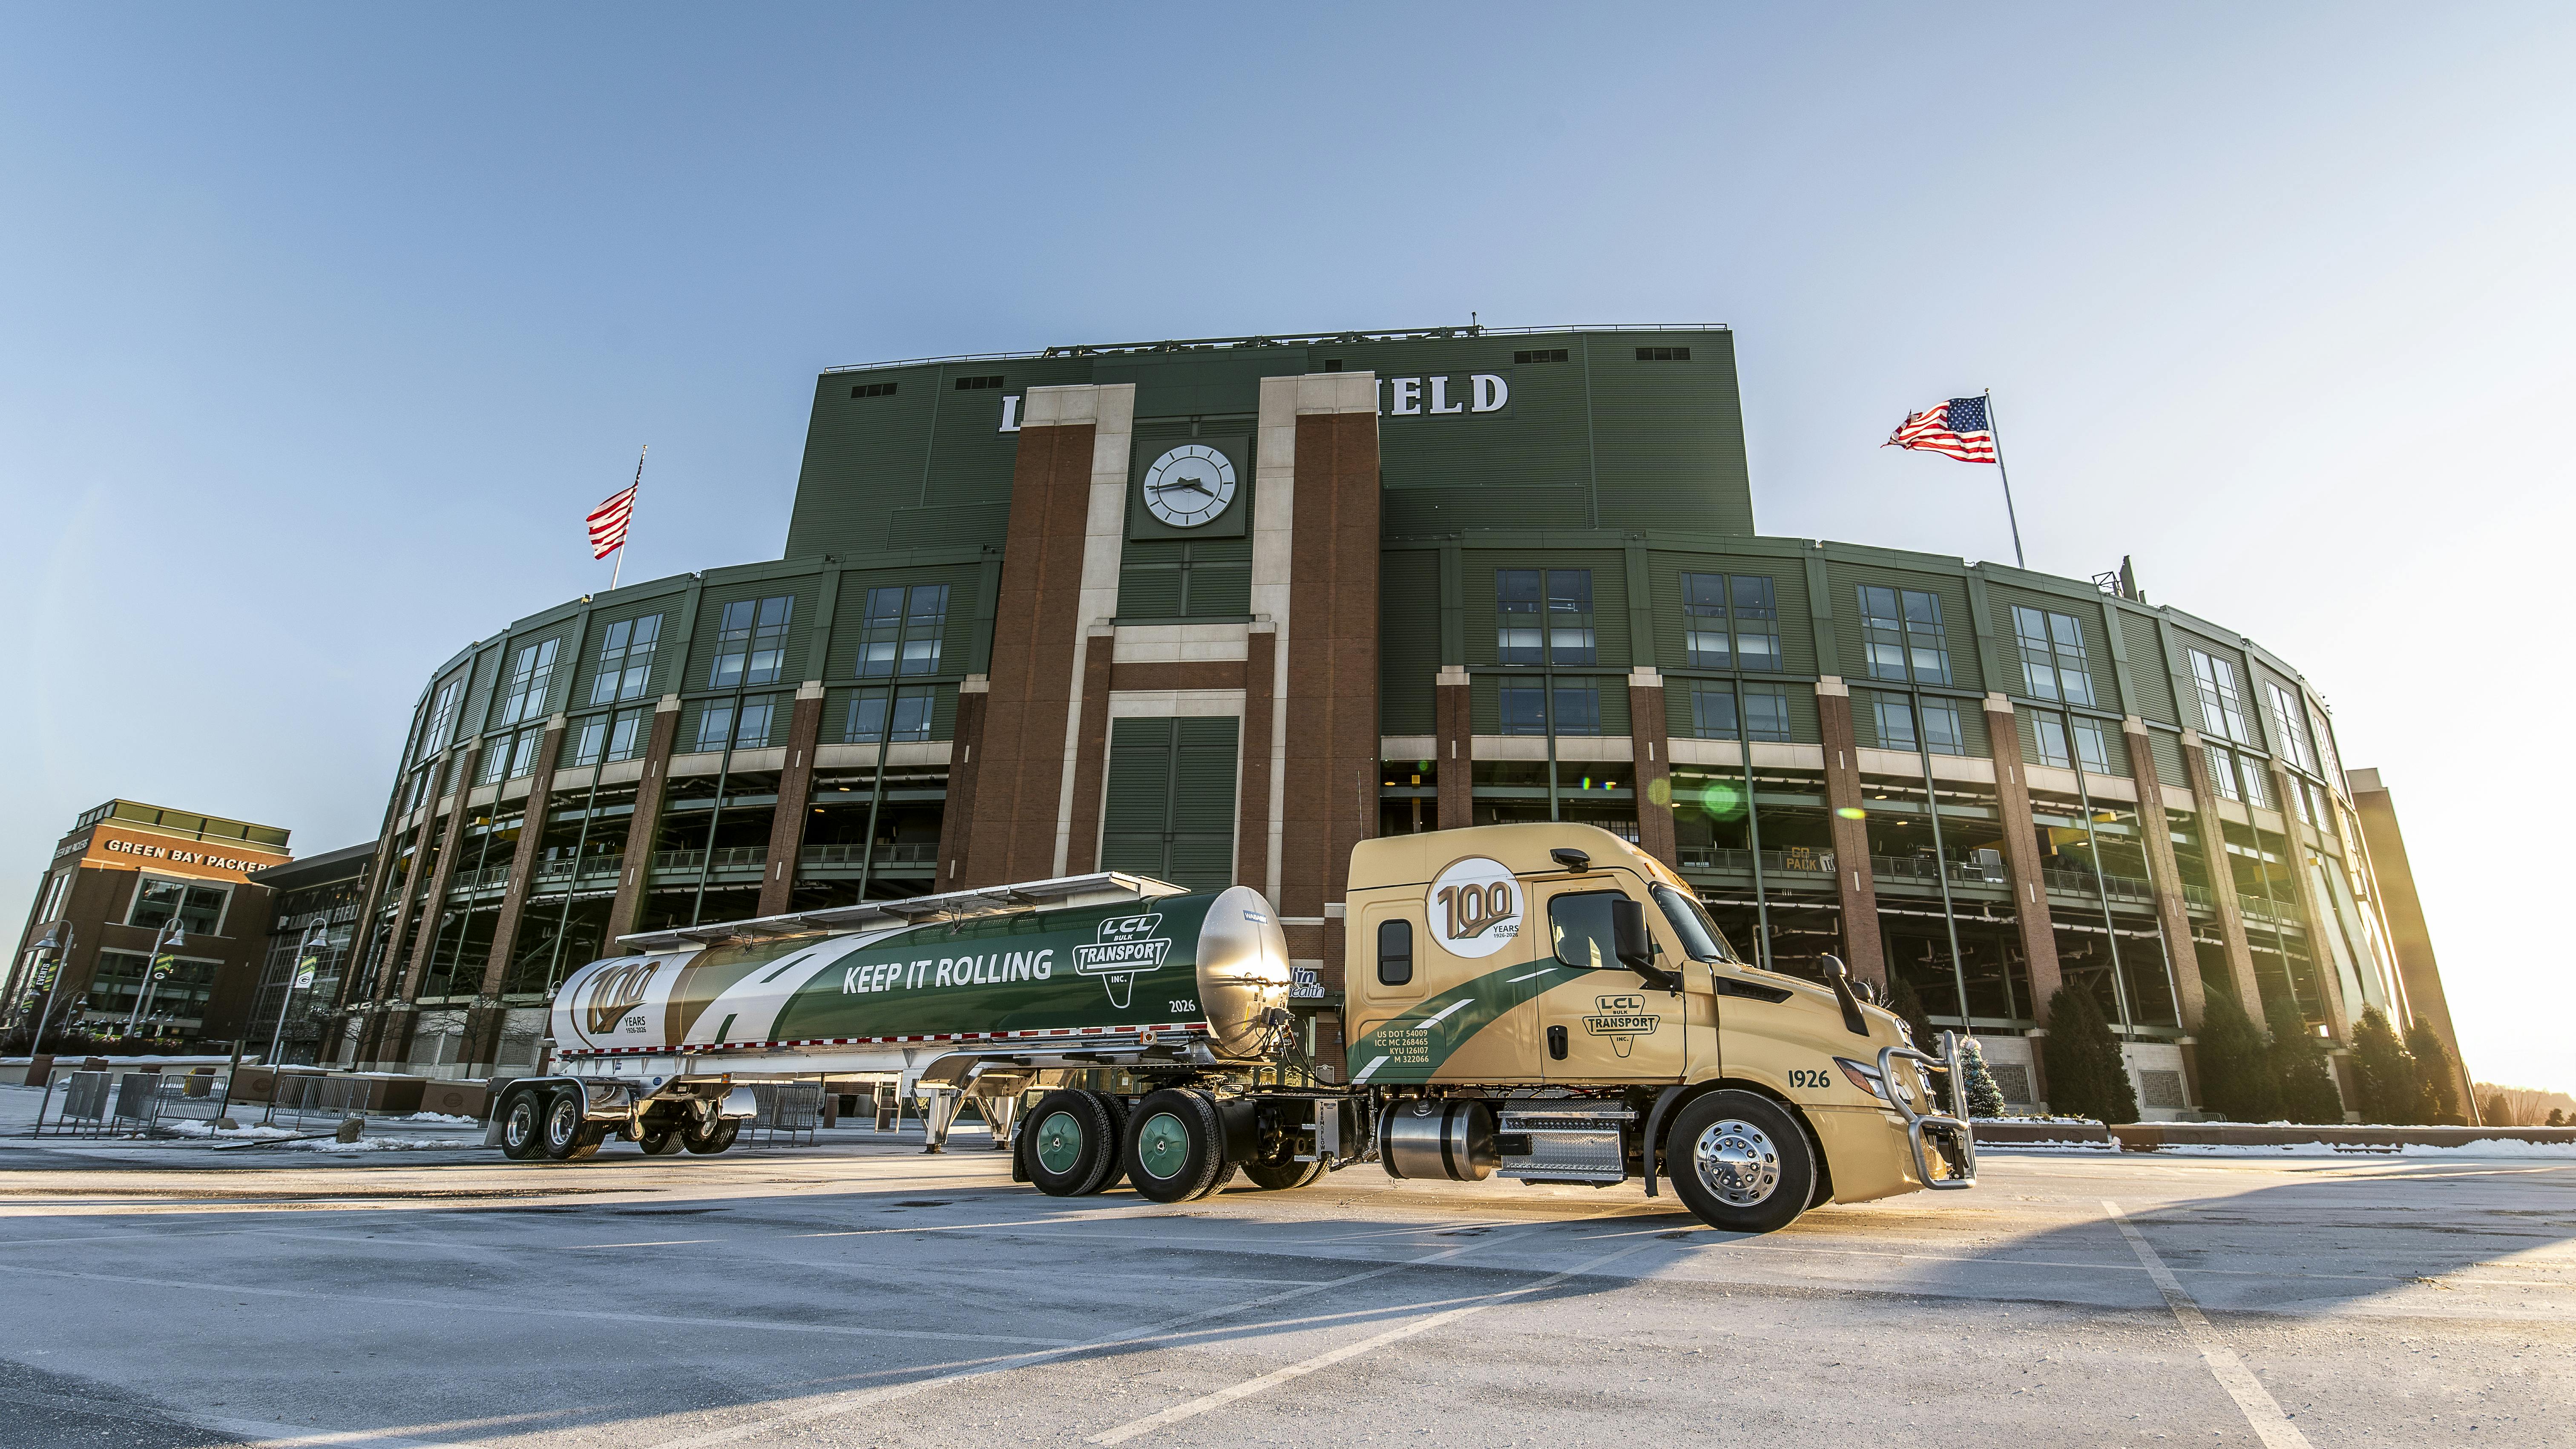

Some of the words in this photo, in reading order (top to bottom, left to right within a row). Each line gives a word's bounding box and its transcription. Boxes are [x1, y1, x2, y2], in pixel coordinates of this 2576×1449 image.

[108, 840, 166, 858] GREEN
[171, 850, 203, 863] BAY
[206, 855, 276, 872] PACKER
[1438, 881, 1512, 940] 100
[1102, 917, 1153, 935] LCL
[1079, 942, 1164, 970] TRANSPORT
[36, 963, 50, 985] EVENTS
[843, 963, 902, 994] KEEP
[906, 959, 932, 989] IT
[935, 949, 1054, 987] ROLLING
[1111, 975, 1127, 983] INC.
[587, 961, 661, 1035] 100
[1169, 999, 1196, 1012] 2026
[1601, 998, 1640, 1009] LCL
[624, 1016, 646, 1026] YEARS
[1588, 1018, 1655, 1032] TRANSPORT
[1788, 1070, 1831, 1088] 1926
